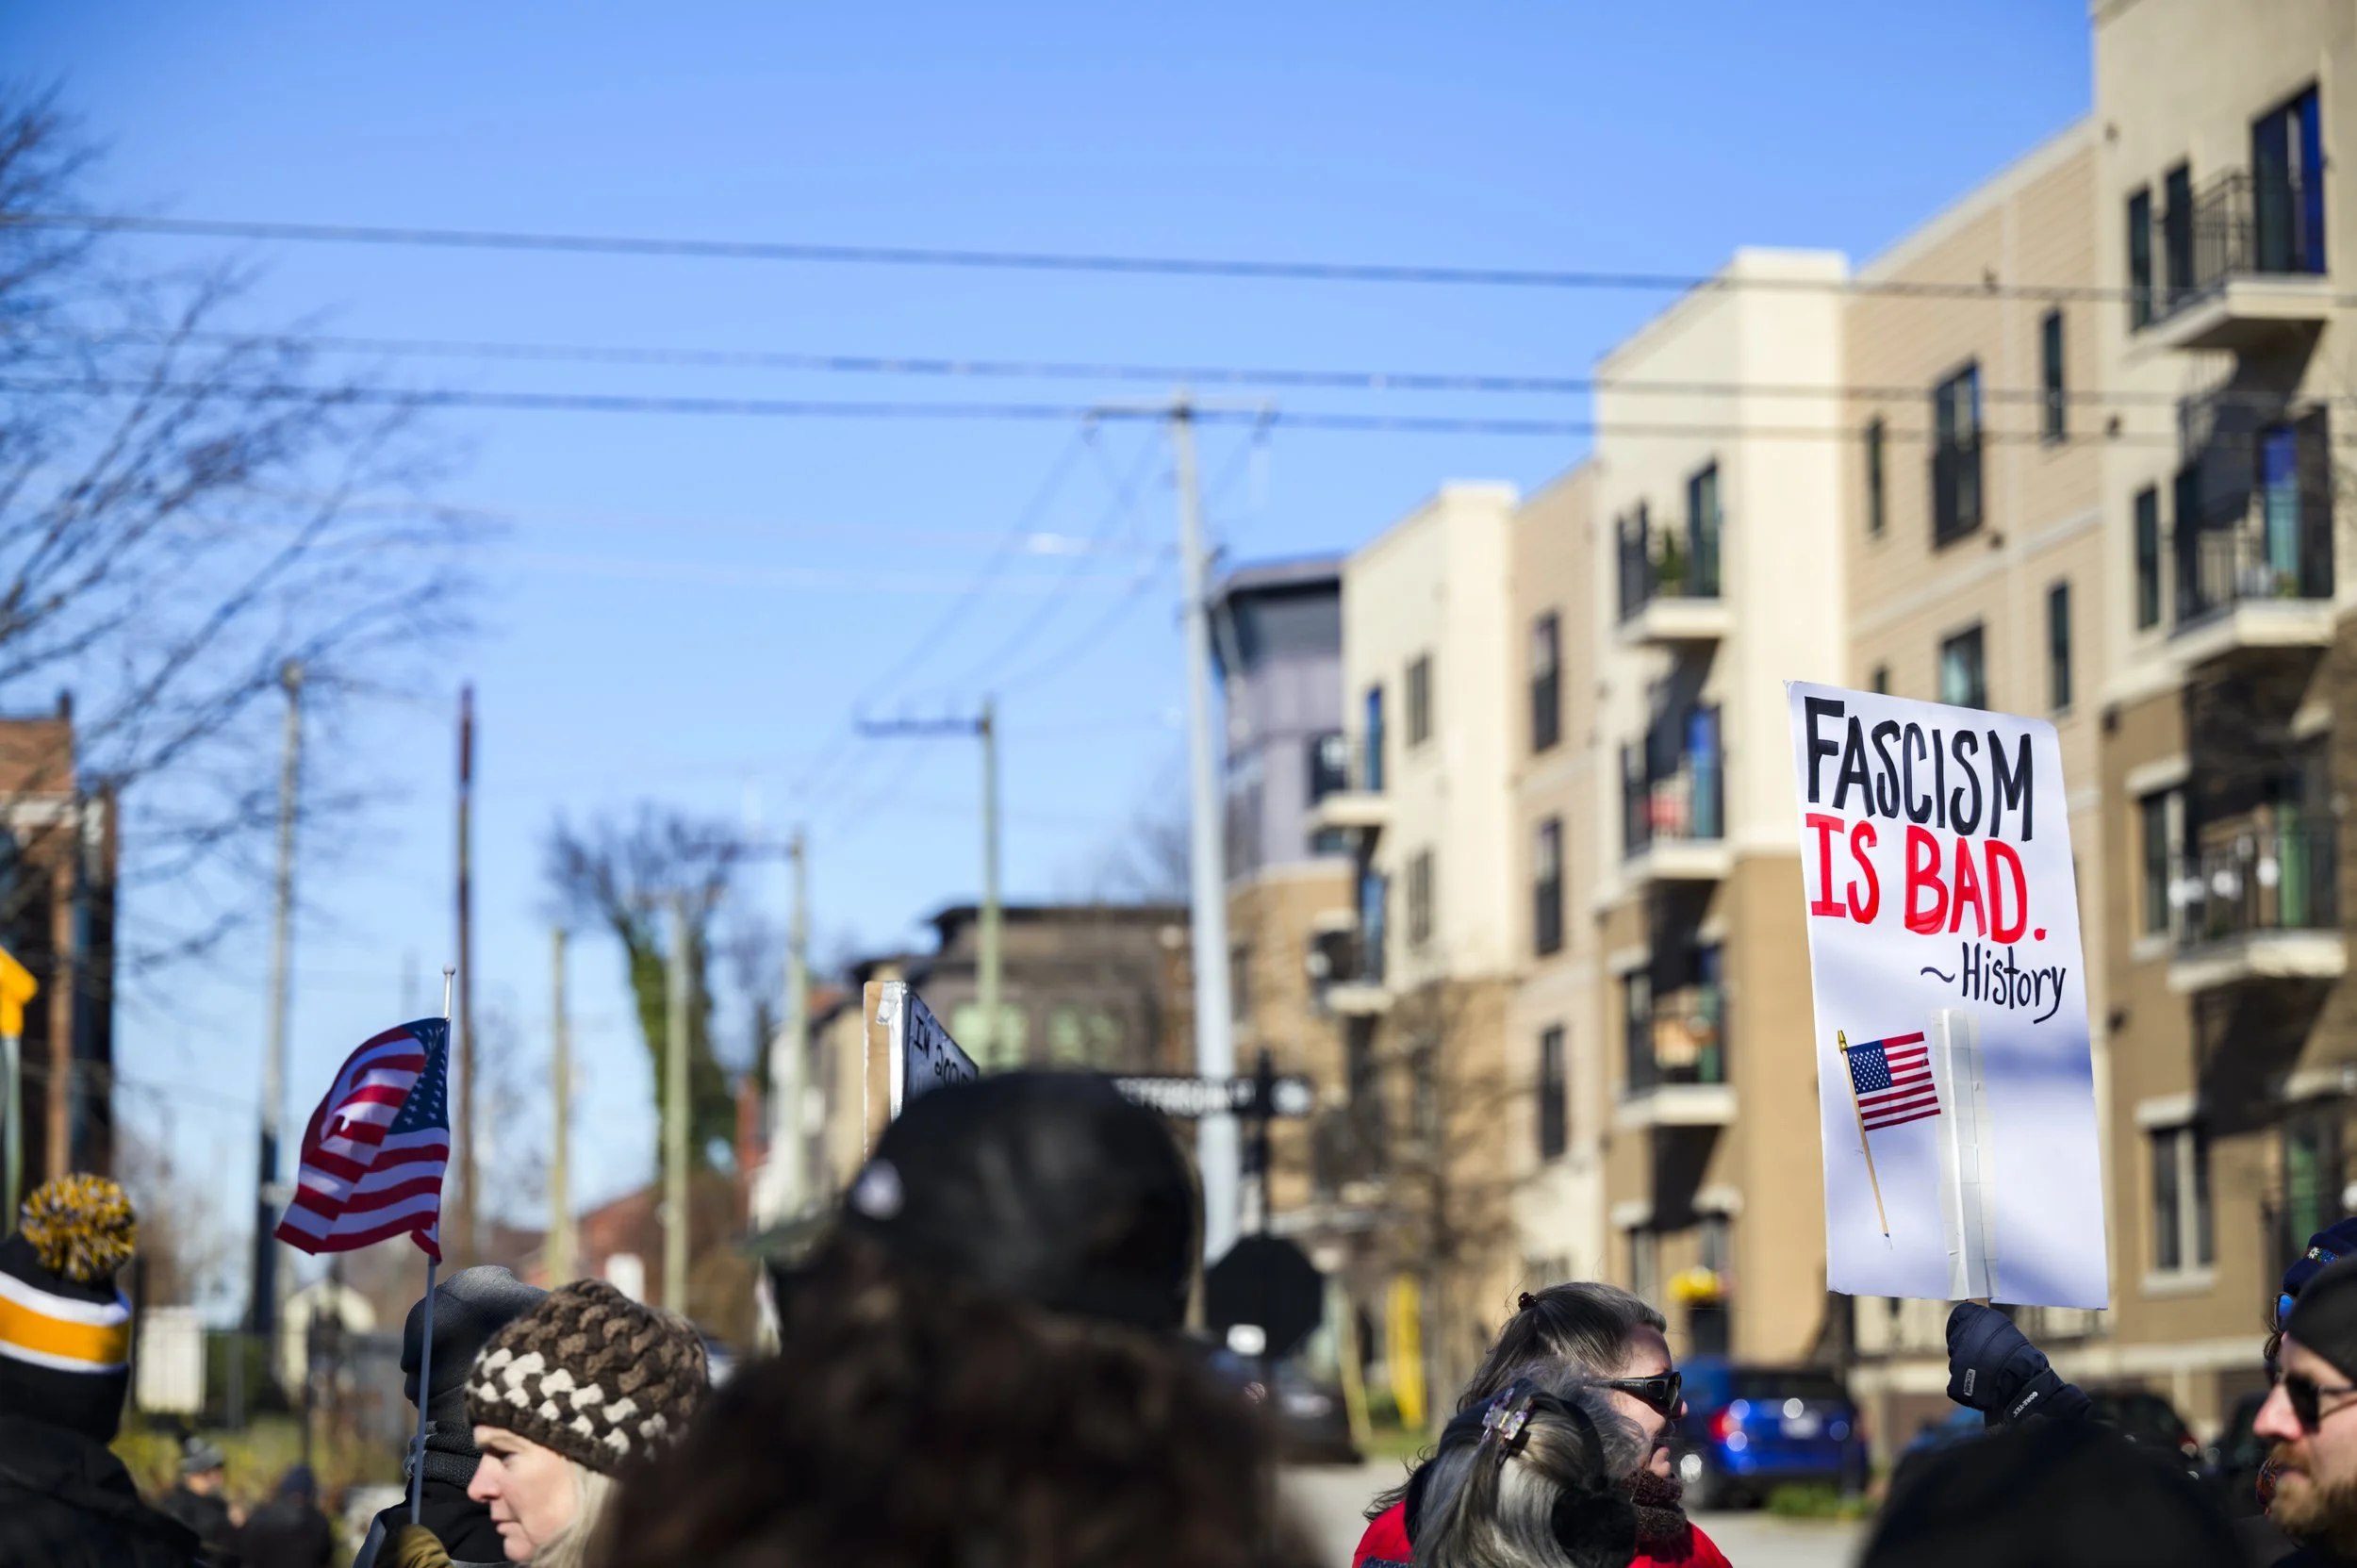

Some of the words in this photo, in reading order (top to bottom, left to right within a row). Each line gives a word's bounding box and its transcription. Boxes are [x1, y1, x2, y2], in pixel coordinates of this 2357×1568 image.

[1804, 696, 2034, 842] FASCISM
[1805, 813, 1880, 924] IS
[1904, 824, 2048, 945] BAD.
[2013, 1391, 2038, 1417] GORE-TEX
